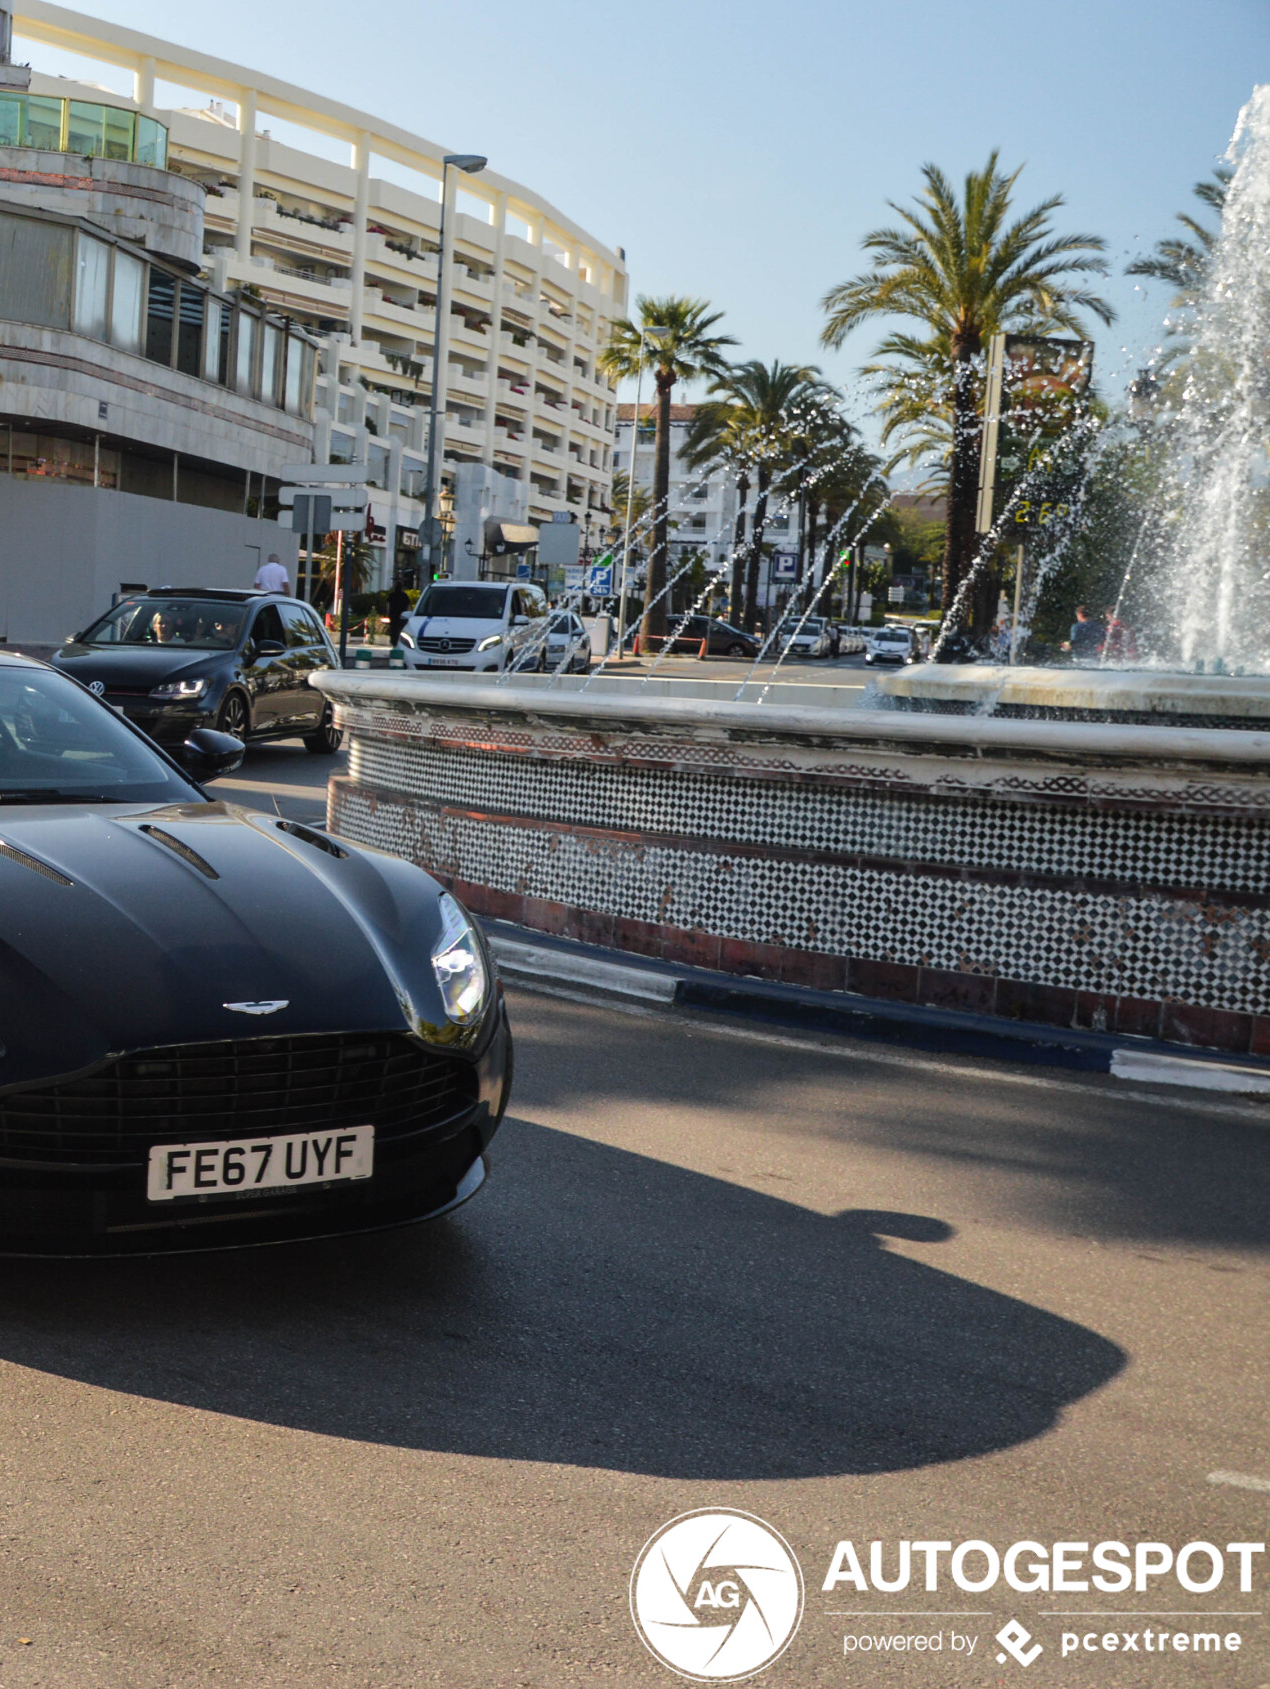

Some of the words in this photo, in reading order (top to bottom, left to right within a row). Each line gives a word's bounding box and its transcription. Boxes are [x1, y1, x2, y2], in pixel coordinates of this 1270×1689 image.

[778, 556, 793, 572] P
[595, 570, 607, 584] P
[166, 1144, 273, 1190] FE67
[285, 1134, 358, 1180] UYF
